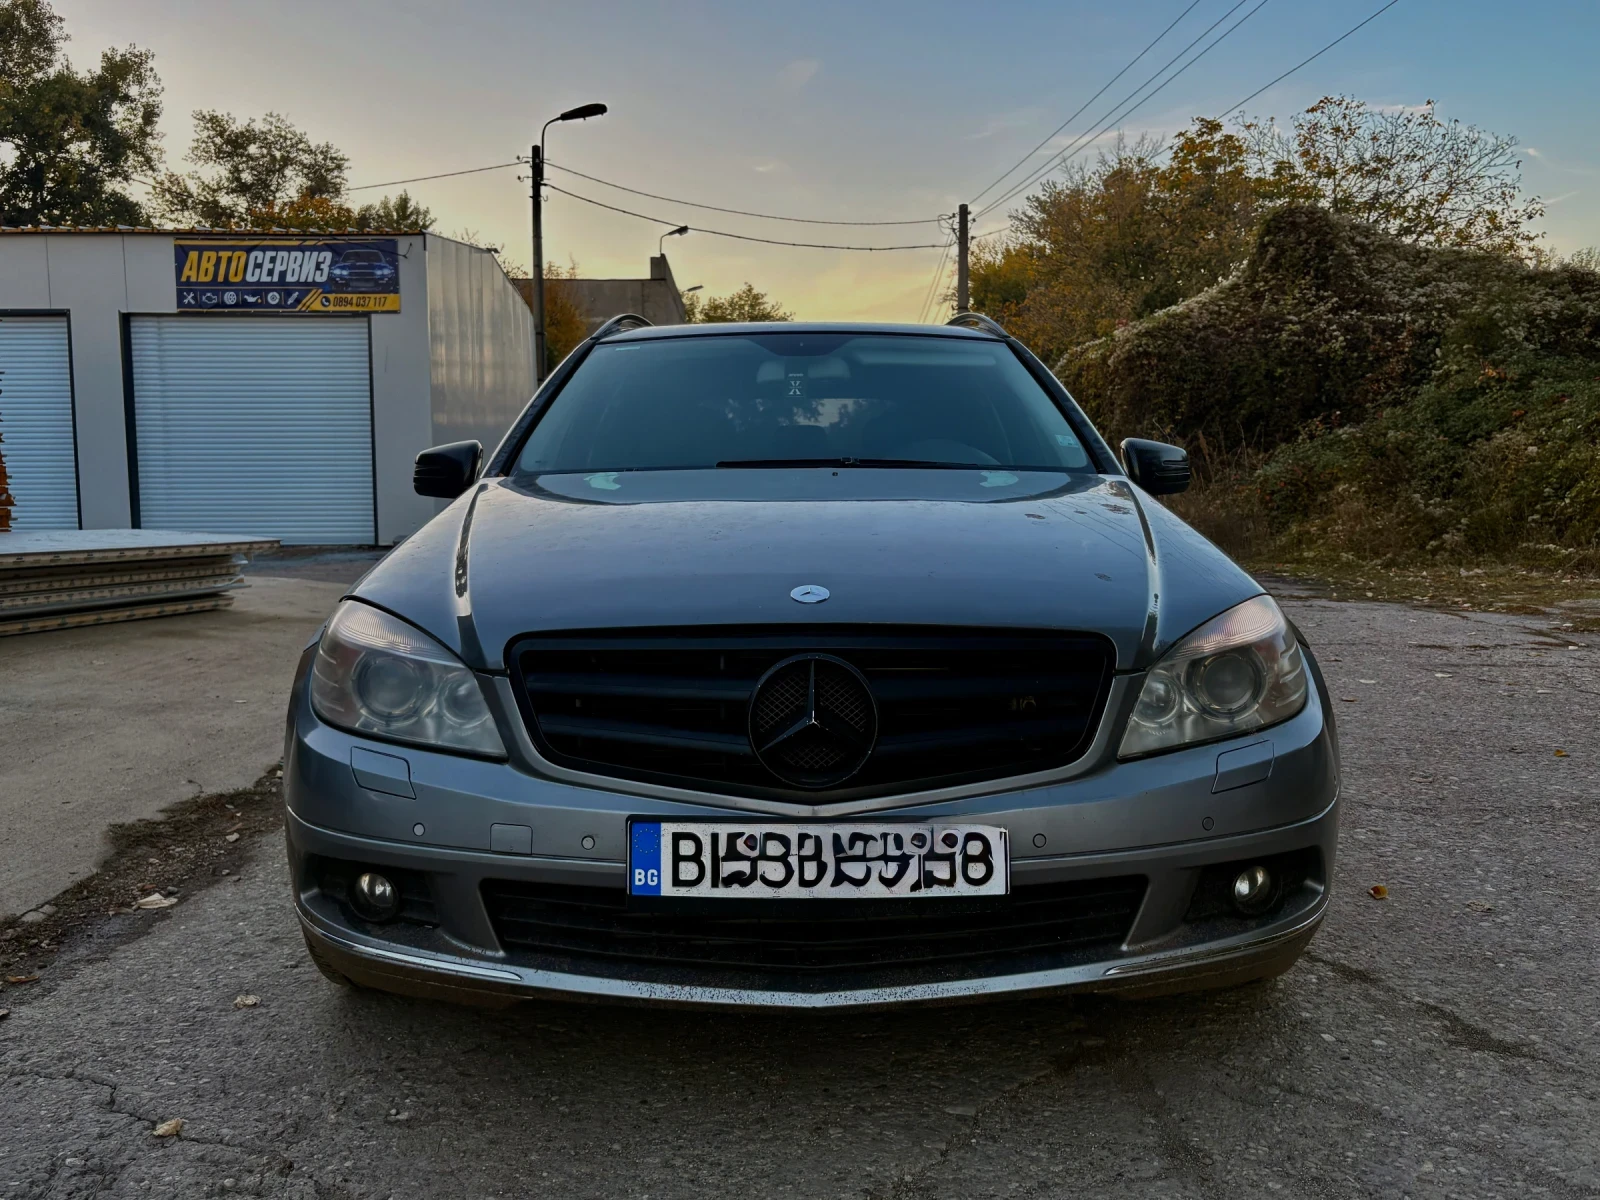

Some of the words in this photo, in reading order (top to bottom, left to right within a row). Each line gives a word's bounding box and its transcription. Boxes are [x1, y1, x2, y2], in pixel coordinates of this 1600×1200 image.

[181, 251, 332, 282] АВТОСЕРВИЗ
[332, 296, 354, 307] 0894
[355, 296, 371, 307] 037
[373, 296, 388, 307] 117
[634, 868, 658, 886] BG
